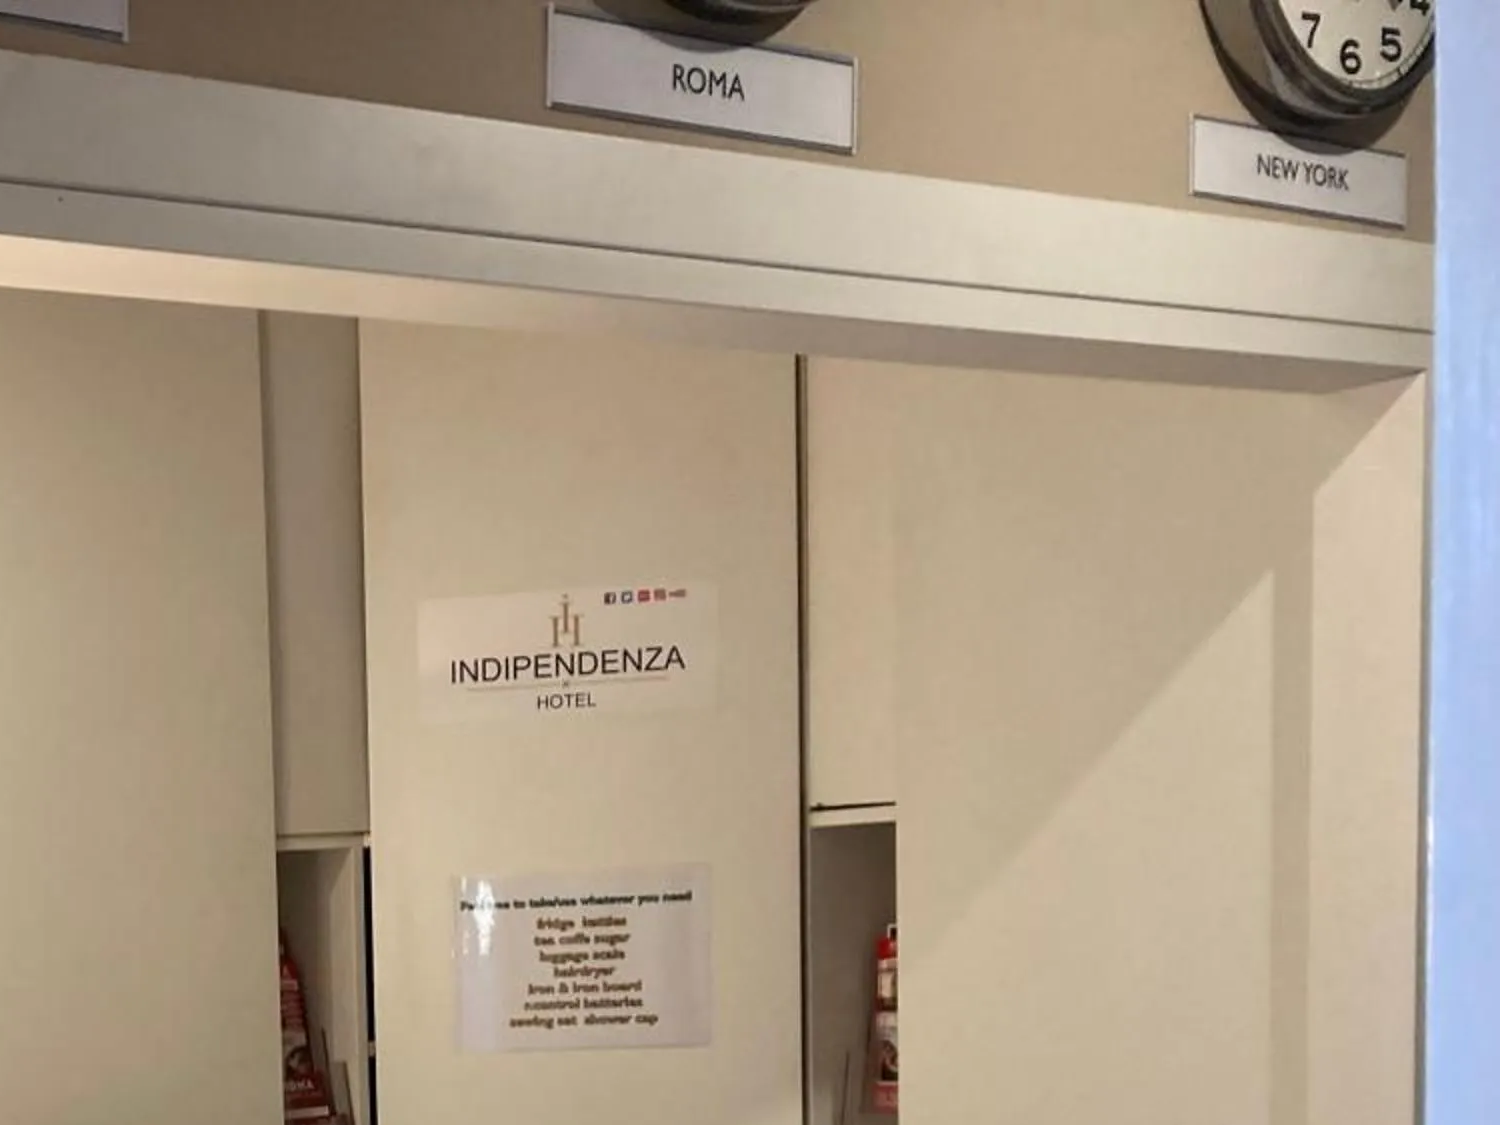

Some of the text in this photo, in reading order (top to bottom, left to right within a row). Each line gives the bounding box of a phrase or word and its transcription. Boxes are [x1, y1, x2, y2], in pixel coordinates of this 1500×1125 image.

[1301, 12, 1321, 48] 7
[1380, 27, 1402, 62] 5
[1339, 38, 1362, 75] 6
[672, 63, 745, 102] ROMA
[1257, 153, 1349, 190] NEW YORK
[451, 645, 686, 684] INDIPENDENZA
[537, 692, 596, 710] HOTEL
[513, 899, 526, 910] to
[637, 895, 659, 907] you
[539, 949, 589, 964] luggage
[593, 933, 631, 946] sugar
